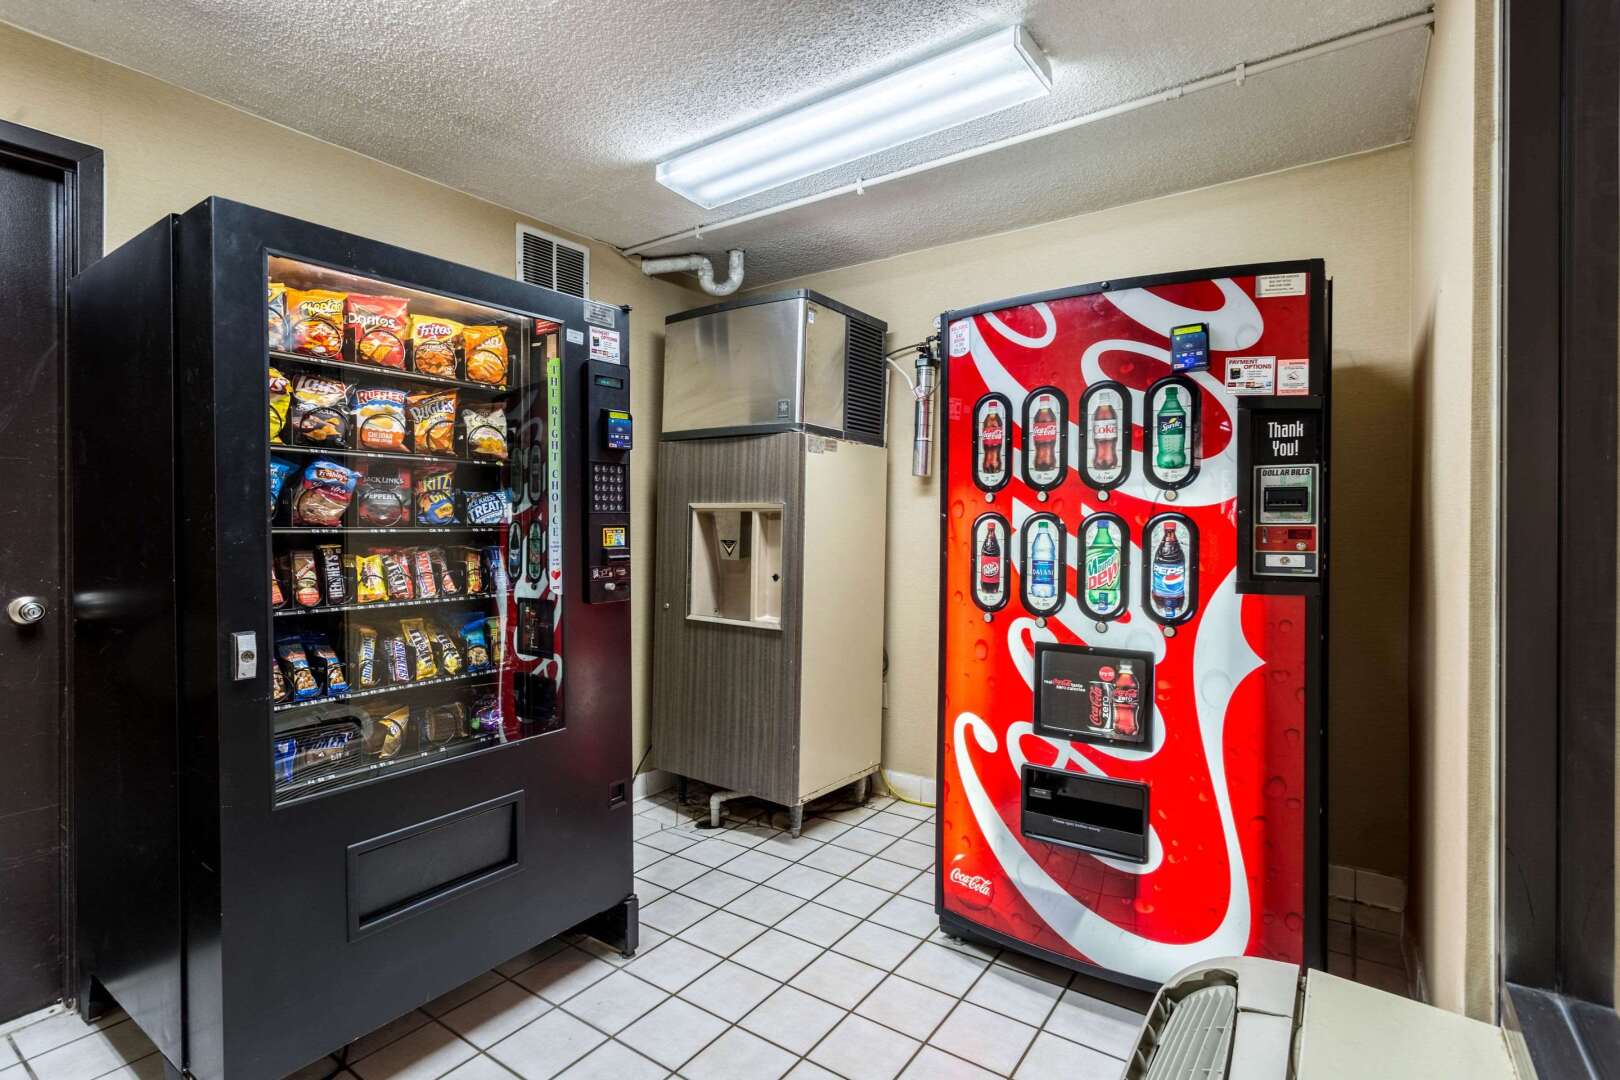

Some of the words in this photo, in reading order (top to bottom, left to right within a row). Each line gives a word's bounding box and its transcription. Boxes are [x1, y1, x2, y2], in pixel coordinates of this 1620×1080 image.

[348, 312, 395, 328] Doritos
[416, 321, 453, 338] Fritos
[1243, 362, 1272, 370] OPTIONS
[356, 389, 404, 405] RUFFLES
[550, 405, 559, 461] RIGHT
[1160, 421, 1183, 432] Sprite
[1266, 420, 1304, 438] Thank
[1272, 440, 1299, 457] You!
[1262, 468, 1290, 477] DOLLAR
[1290, 467, 1311, 476] BILLS
[423, 472, 452, 491] RITZ
[551, 469, 559, 537] CHOICE
[1032, 568, 1054, 576] DASANI
[1153, 565, 1185, 574] PEPS
[950, 867, 993, 896] Coca-Cola
